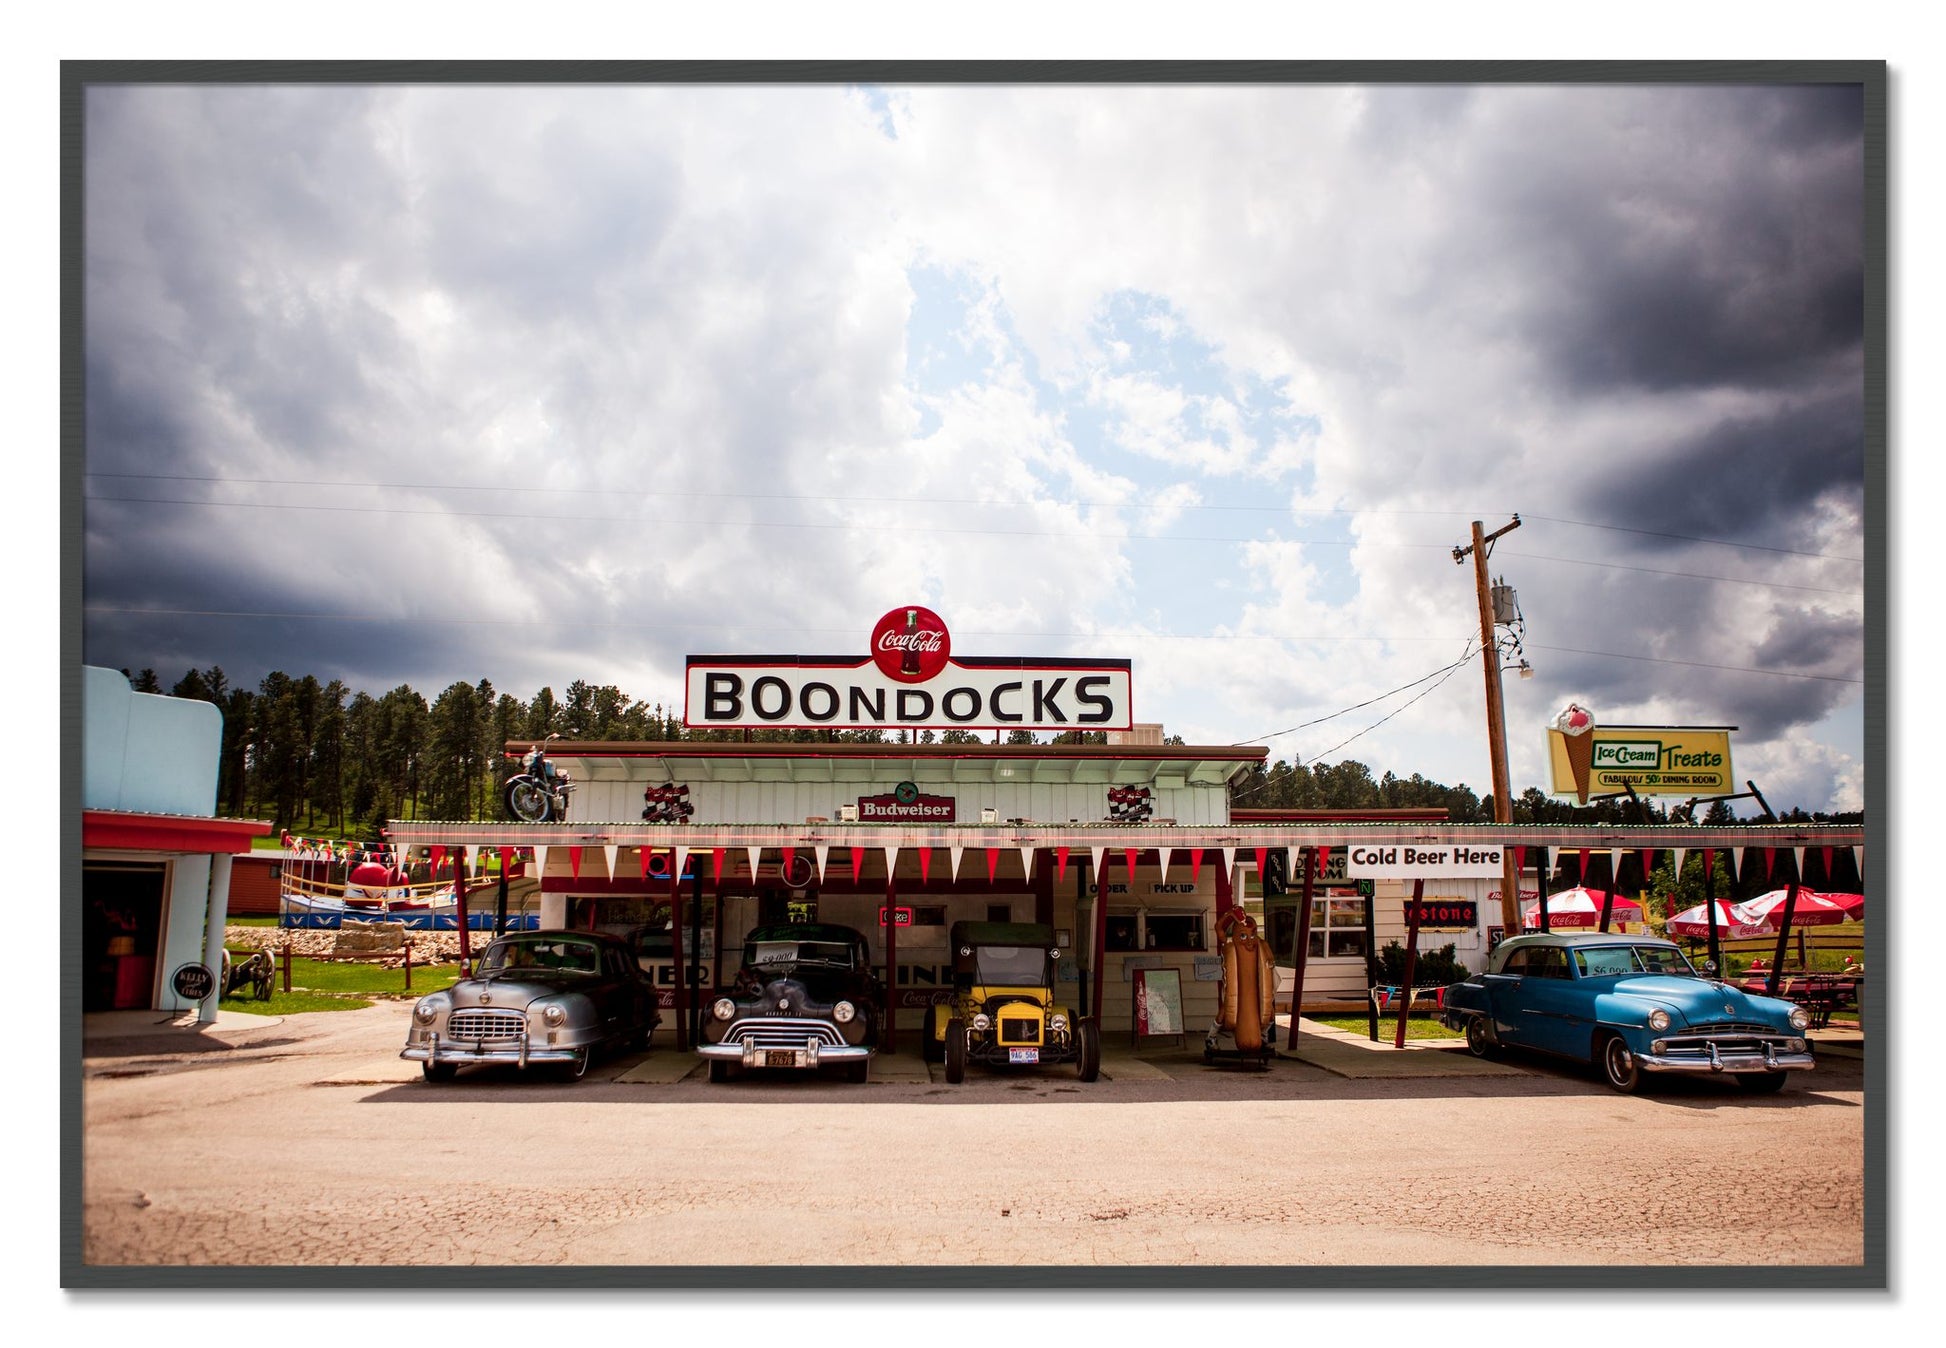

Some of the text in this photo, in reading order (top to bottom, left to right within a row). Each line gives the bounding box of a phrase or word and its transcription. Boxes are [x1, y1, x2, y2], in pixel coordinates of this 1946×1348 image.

[704, 671, 1114, 723] BOONDOCKS
[1597, 745, 1722, 770] Ice Cream Treats
[1603, 775, 1643, 784] FABULOUS
[1662, 776, 1690, 784] DINING
[1692, 776, 1717, 784] ROOM
[862, 802, 951, 816] Budweiser
[1352, 848, 1500, 865] Cold Beer Here
[1090, 884, 1128, 893] ODER
[1154, 884, 1194, 893] PICK UP
[883, 911, 909, 923] Cke
